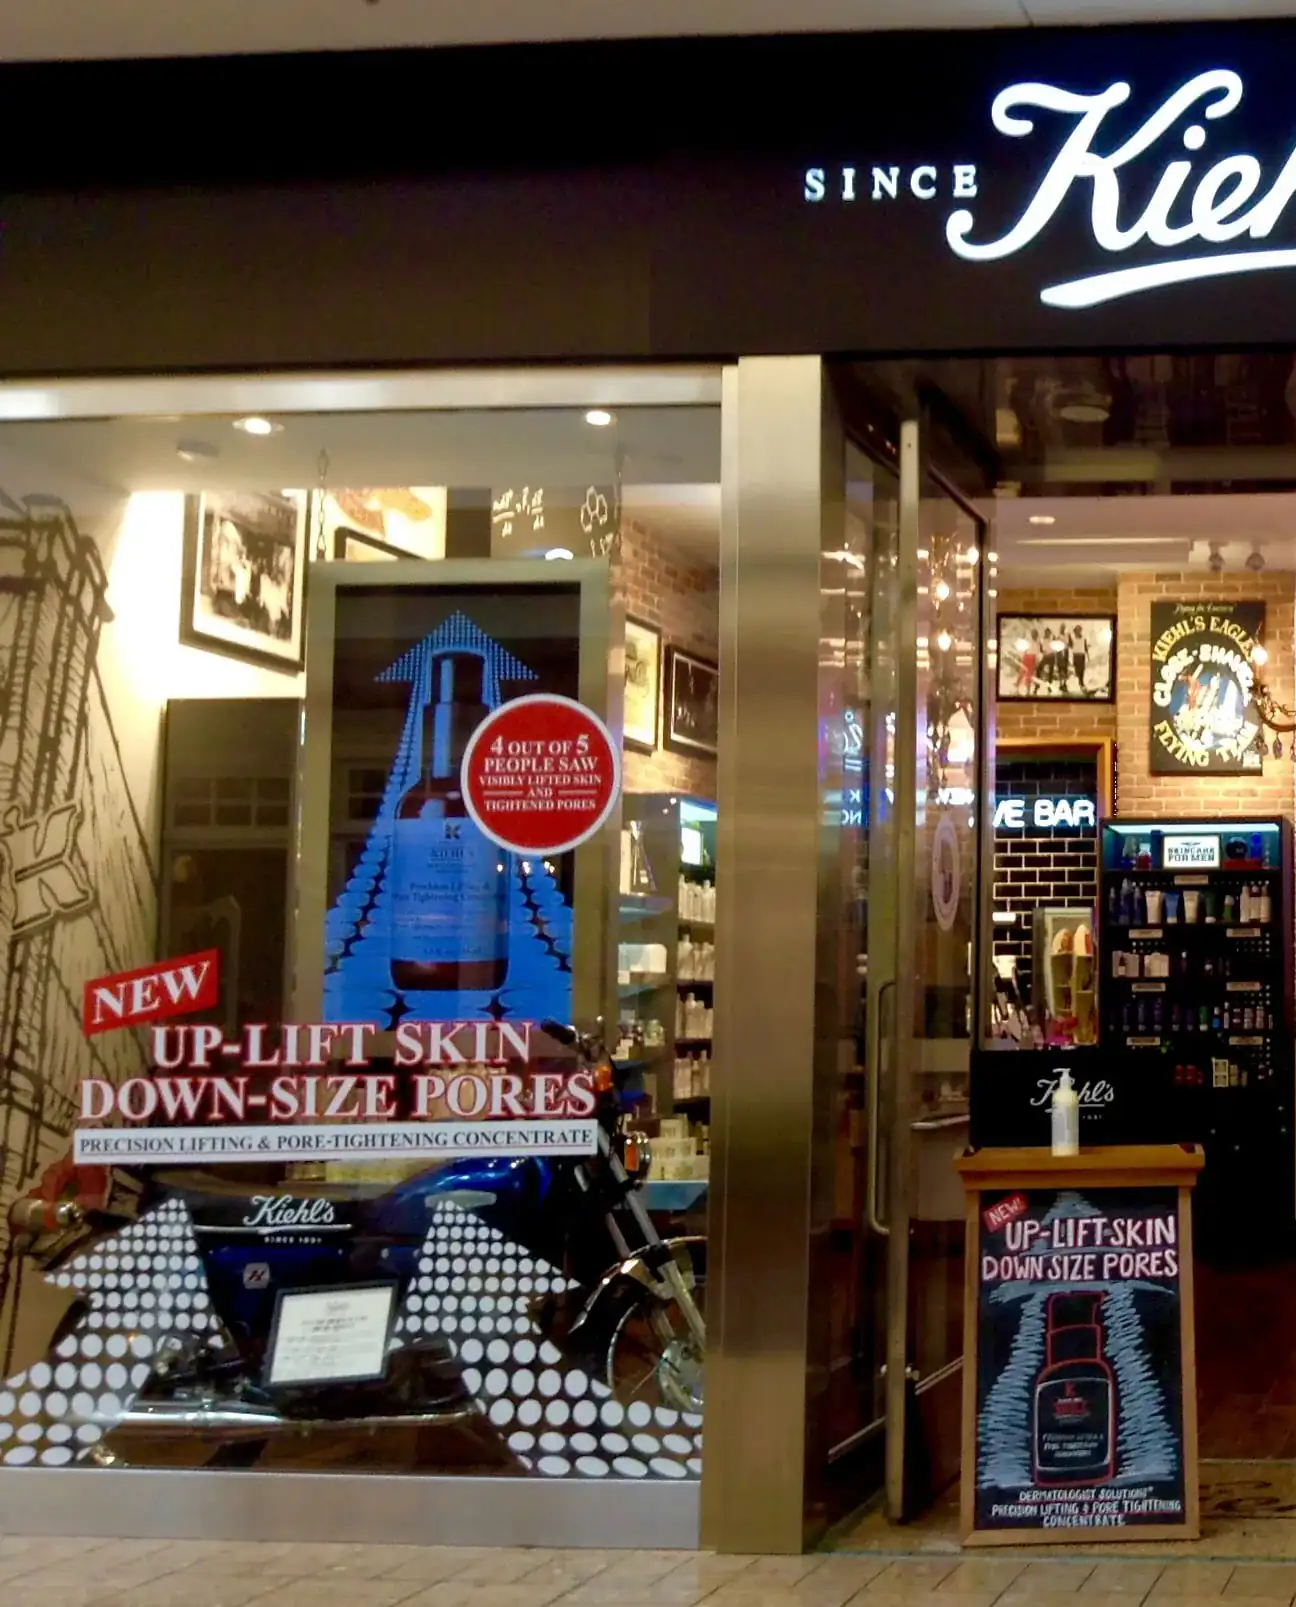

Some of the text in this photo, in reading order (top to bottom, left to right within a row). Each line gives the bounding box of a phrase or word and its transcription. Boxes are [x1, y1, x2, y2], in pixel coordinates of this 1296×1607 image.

[804, 164, 978, 200] SINCE
[1151, 614, 1206, 663] KIEHL'S
[490, 733, 590, 756] 4 OUT OF 5
[1153, 720, 1210, 767] FLYING
[484, 756, 598, 773] PEOPLE SAW
[479, 773, 602, 786] VISIBLY LIFTED SKIN
[526, 786, 553, 797] AND
[484, 799, 596, 812] TIGHTENED PORES
[1034, 799, 1095, 828] BAR
[1168, 853, 1215, 862] FOR MEN
[91, 960, 211, 1025] NEW
[151, 1021, 536, 1069] UP-LIFT SKIN
[79, 1073, 596, 1121] DOWN-SIZE PORES
[80, 1128, 593, 1153] PRECISION LIFTING & PORE-TIGHTENING CONCENTRATE
[243, 1195, 335, 1225] Kiehl's
[988, 1198, 1022, 1226] NEW!
[1005, 1215, 1176, 1251] UP-LIFT SKIN
[982, 1249, 1178, 1281] DOWN SIZE PORES
[1019, 1488, 1096, 1501] DERMATOLOGIST
[1040, 1504, 1080, 1516] LIFTING
[1092, 1502, 1119, 1514] PORE
[1123, 1500, 1182, 1513] TIGHTENING
[1042, 1514, 1126, 1527] CONCENTRATE
